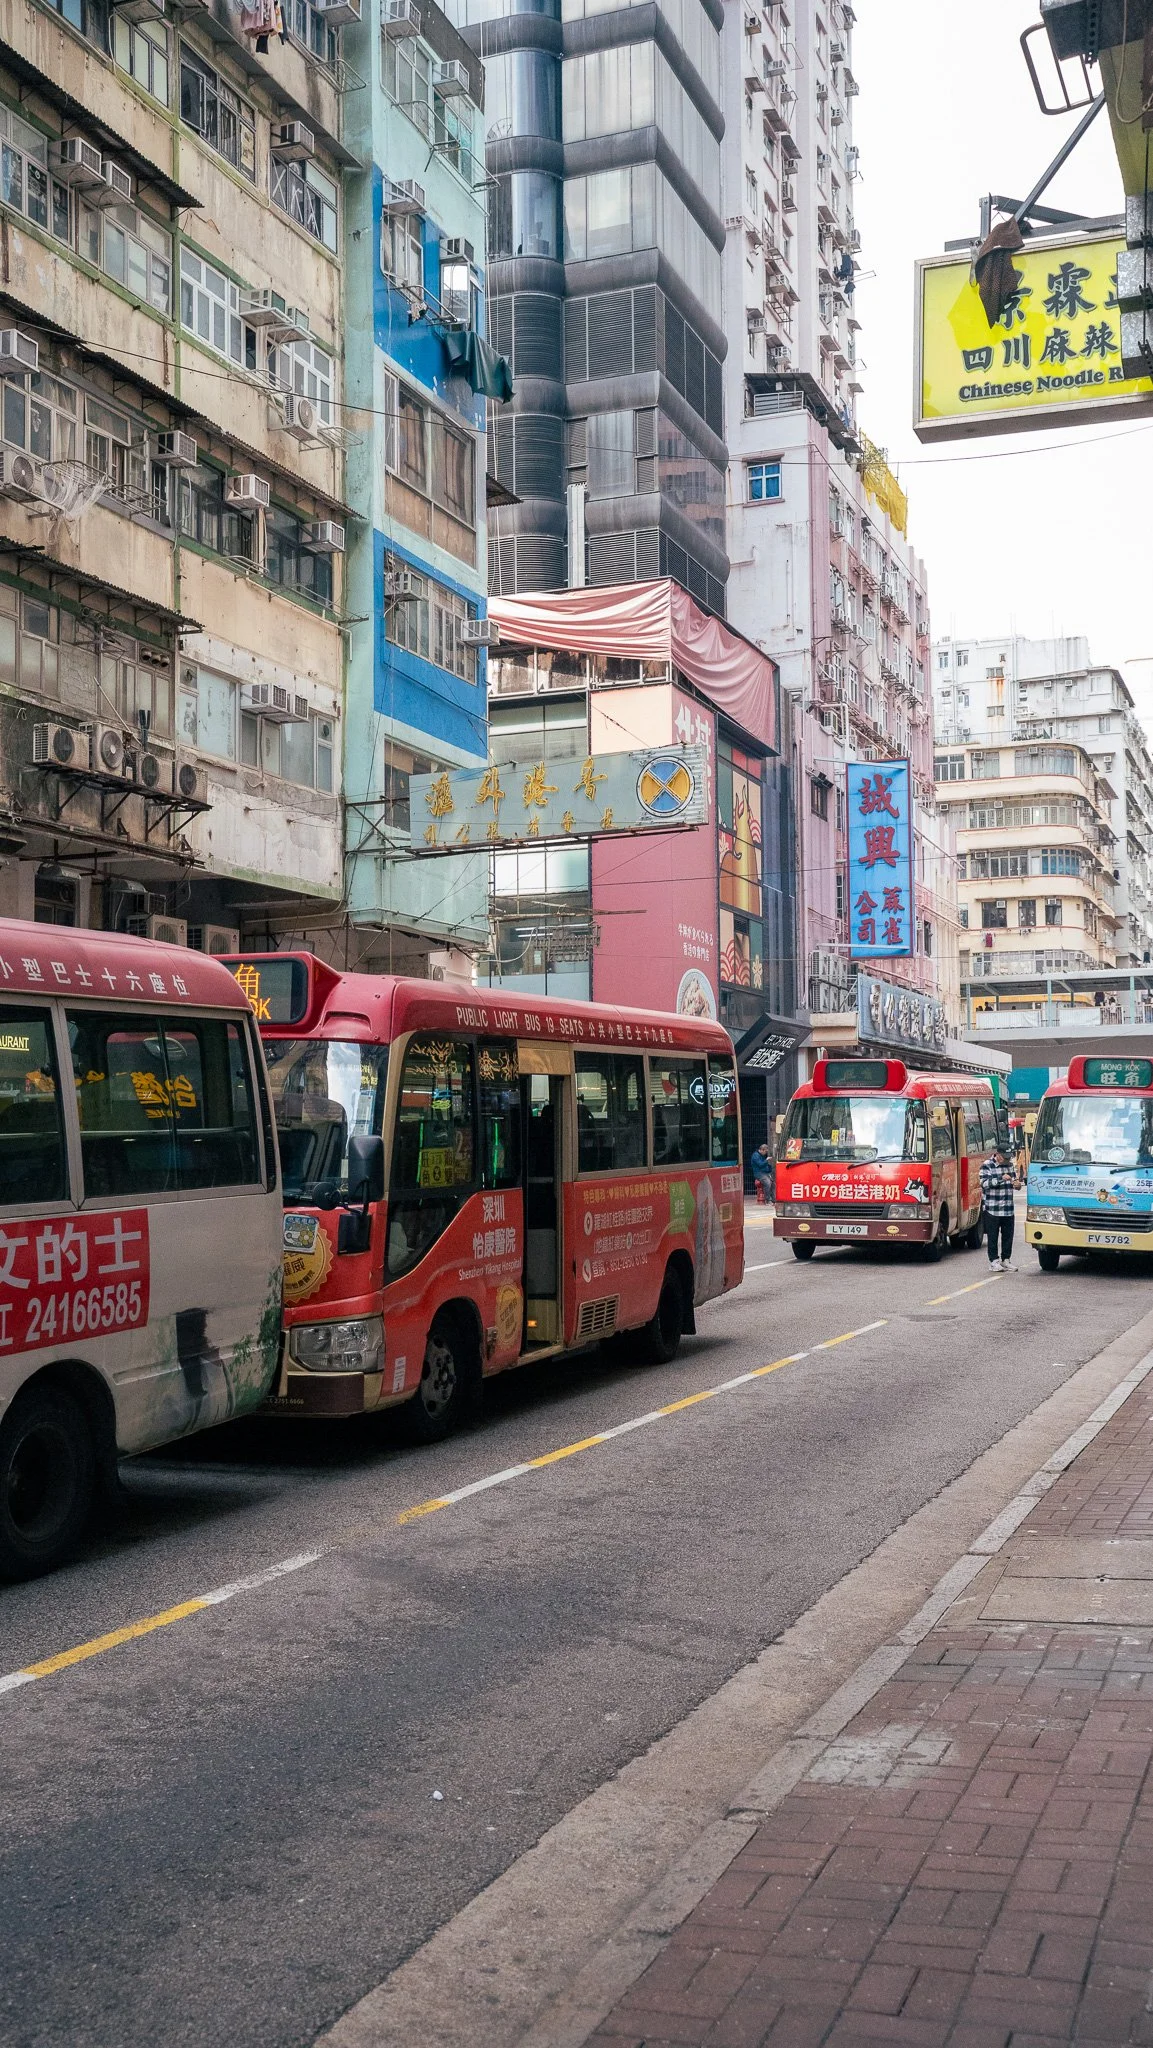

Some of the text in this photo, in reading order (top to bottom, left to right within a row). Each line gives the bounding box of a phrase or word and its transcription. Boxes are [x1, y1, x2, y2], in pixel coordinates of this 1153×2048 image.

[962, 321, 1119, 373] 四川麻辣
[959, 380, 1034, 402] Chinese
[1036, 370, 1104, 393] Noodle
[858, 773, 900, 870] 誠興
[854, 890, 878, 945] 公司
[234, 963, 261, 999] 角
[456, 1006, 489, 1027] PUBLIC
[494, 1010, 518, 1030] LIGHT
[525, 1013, 541, 1032] BUS
[546, 1016, 554, 1033] 19
[559, 1017, 584, 1036] SEATS
[1100, 1072, 1139, 1086] 旺角
[1101, 1063, 1122, 1071] MONG
[791, 1183, 901, 1200] 自1979起送港奶
[482, 1194, 505, 1223] 深圳
[473, 1226, 516, 1260] 怡康醫院
[847, 1225, 862, 1234] 149
[1088, 1234, 1130, 1244] FV 5782
[458, 1256, 522, 1281] Shenzhen Yikang Hospital
[25, 1280, 142, 1342] 24166585
